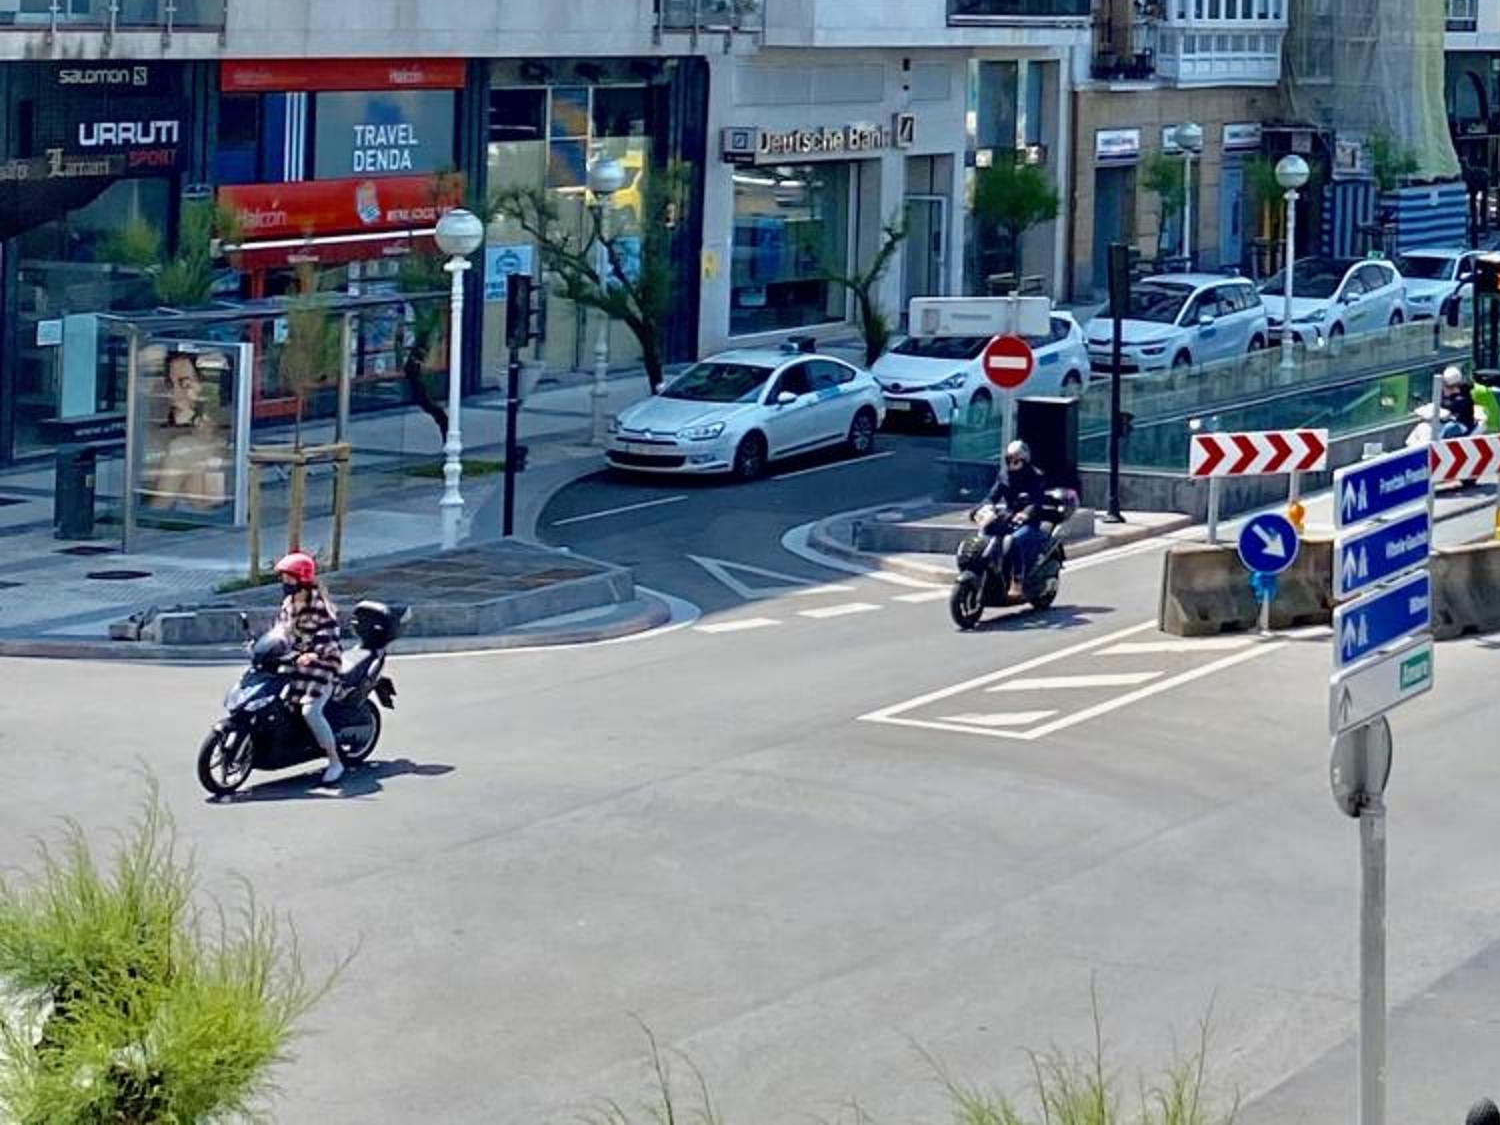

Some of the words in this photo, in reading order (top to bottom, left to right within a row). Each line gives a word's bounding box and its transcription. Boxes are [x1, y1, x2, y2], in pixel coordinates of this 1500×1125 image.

[79, 120, 179, 146] URRUTI
[353, 124, 418, 146] TRAVEL
[128, 148, 177, 168] SPORT
[353, 149, 412, 172] DENDA
